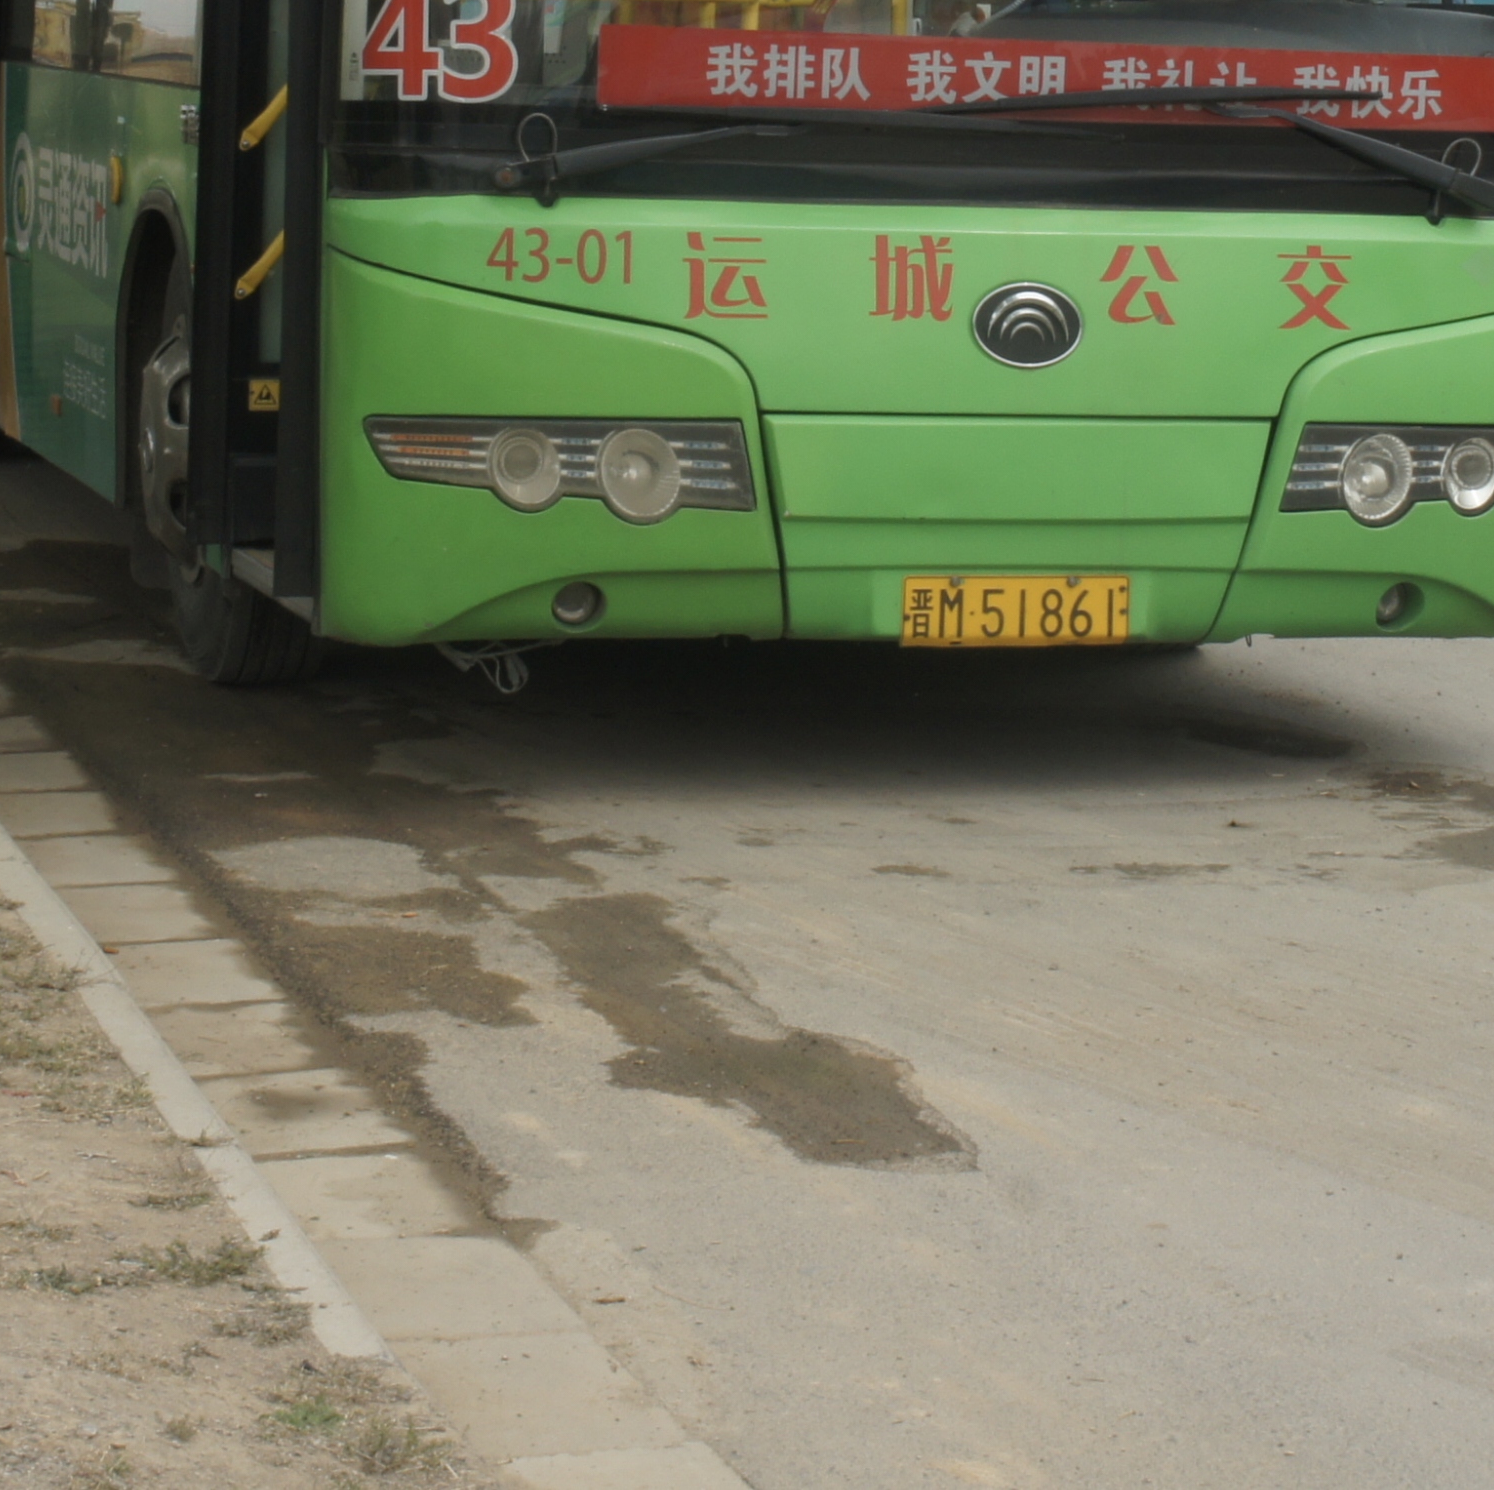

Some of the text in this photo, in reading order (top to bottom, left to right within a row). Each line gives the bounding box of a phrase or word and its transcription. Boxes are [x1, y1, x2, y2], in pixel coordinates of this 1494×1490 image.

[706, 43, 871, 101] 我排队
[906, 50, 1067, 104] 我文明
[1293, 64, 1442, 119] 我快乐
[485, 227, 633, 285] 43-01
